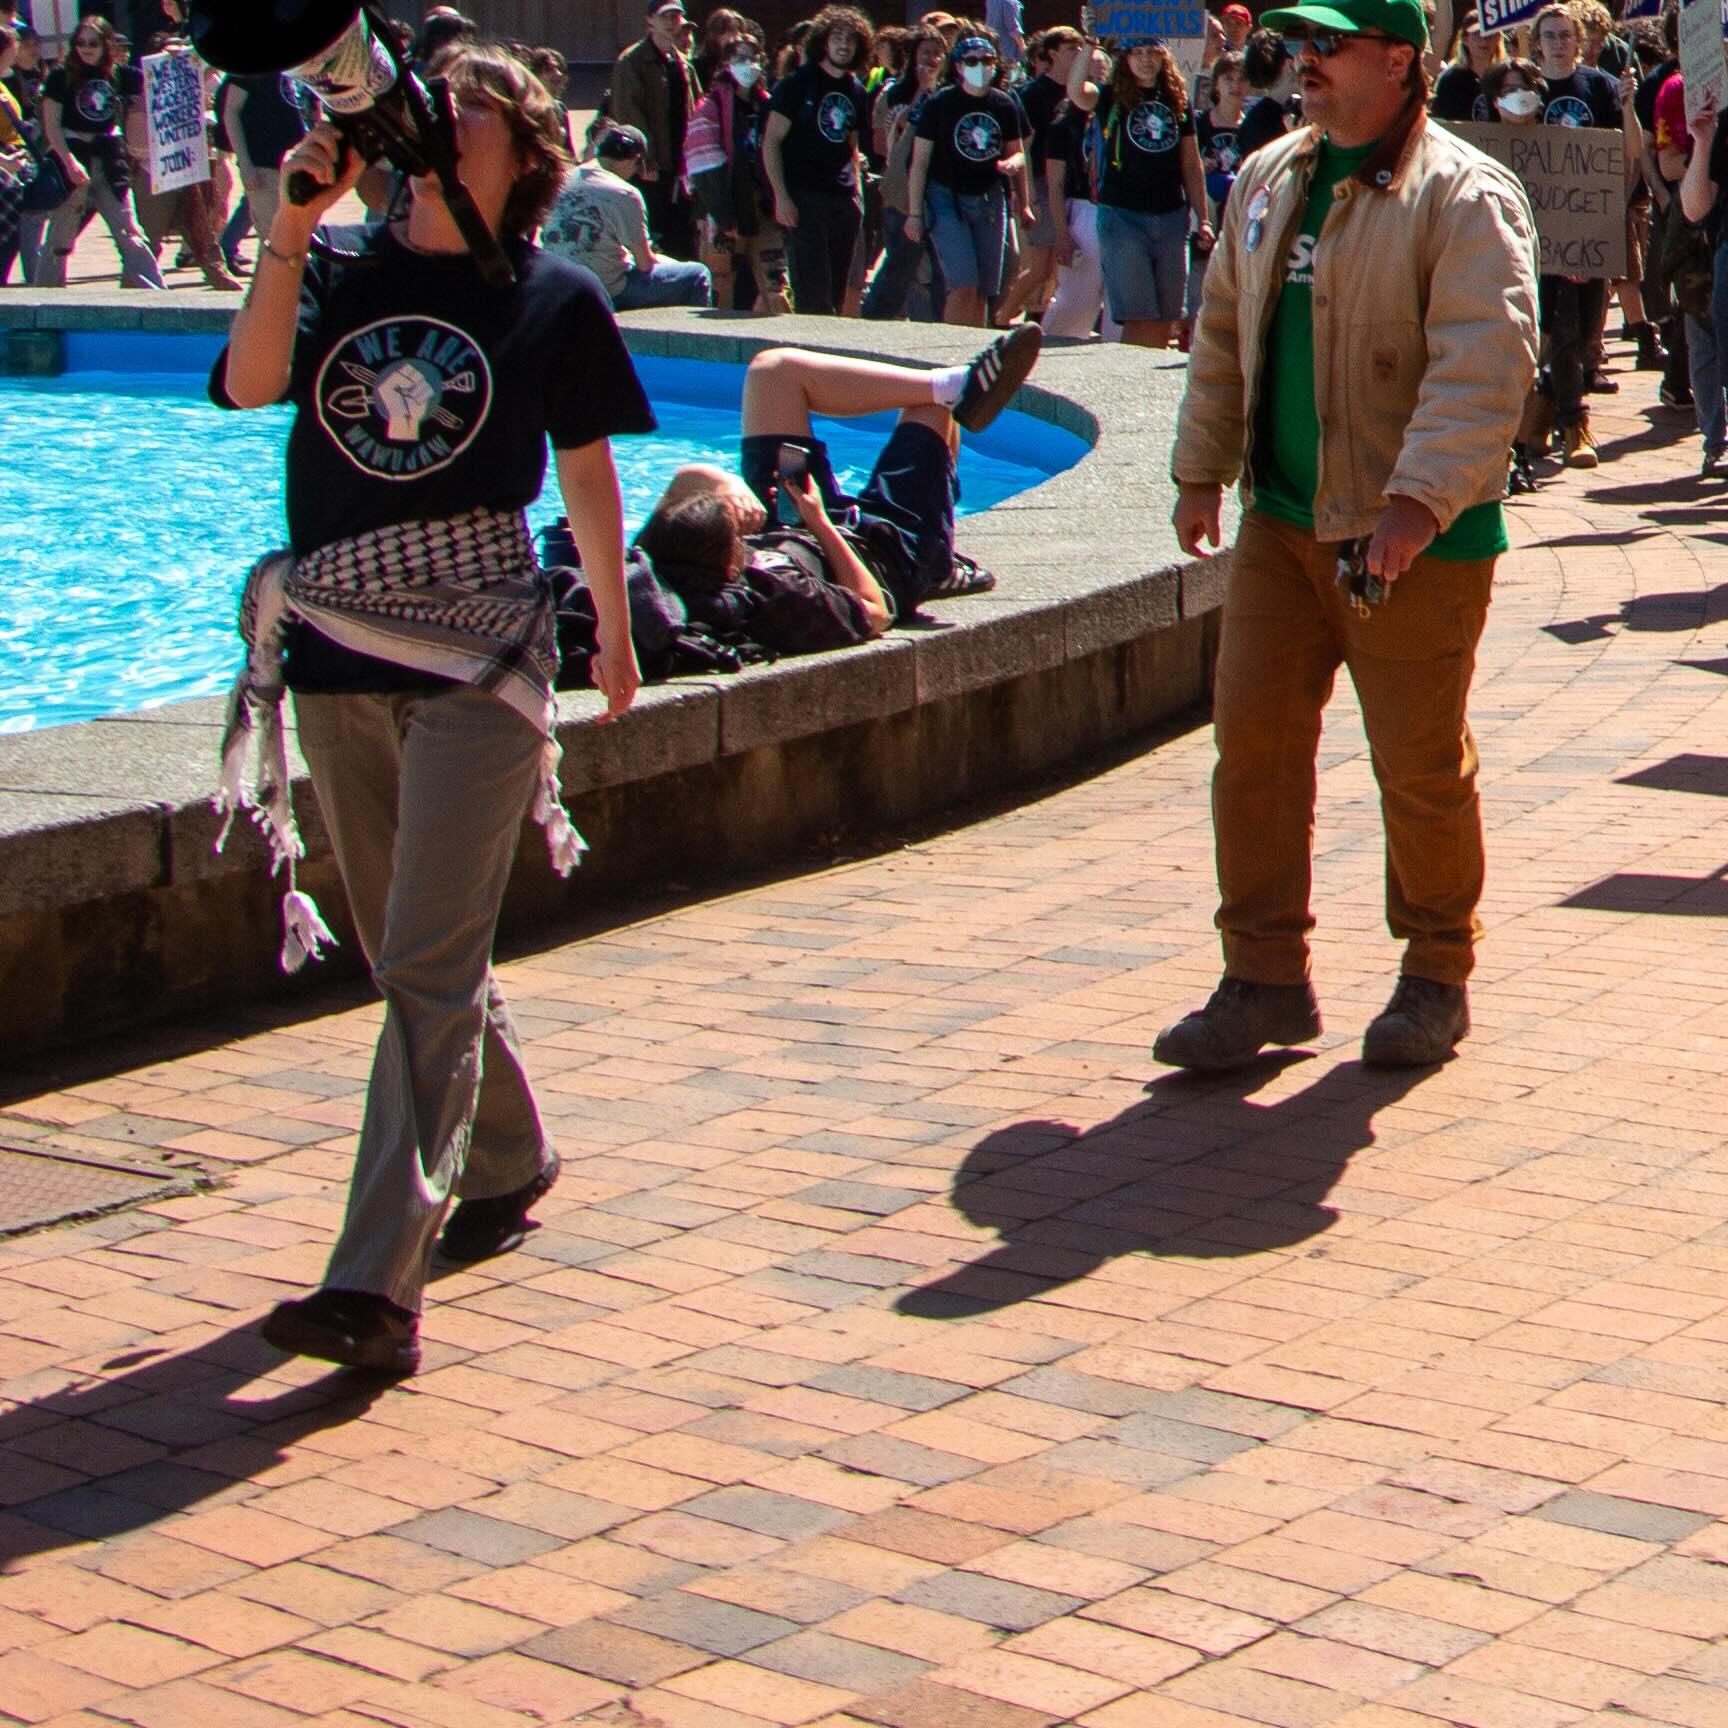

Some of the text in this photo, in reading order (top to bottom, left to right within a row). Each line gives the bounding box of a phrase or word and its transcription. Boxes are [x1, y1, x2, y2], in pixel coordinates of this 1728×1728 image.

[1095, 9, 1202, 35] WORKERS
[160, 120, 201, 146] UNITED
[1511, 138, 1623, 175] BALANCE
[1526, 182, 1613, 215] BUDGET
[1540, 235, 1610, 268] BACKS
[354, 327, 477, 374] WE ARE
